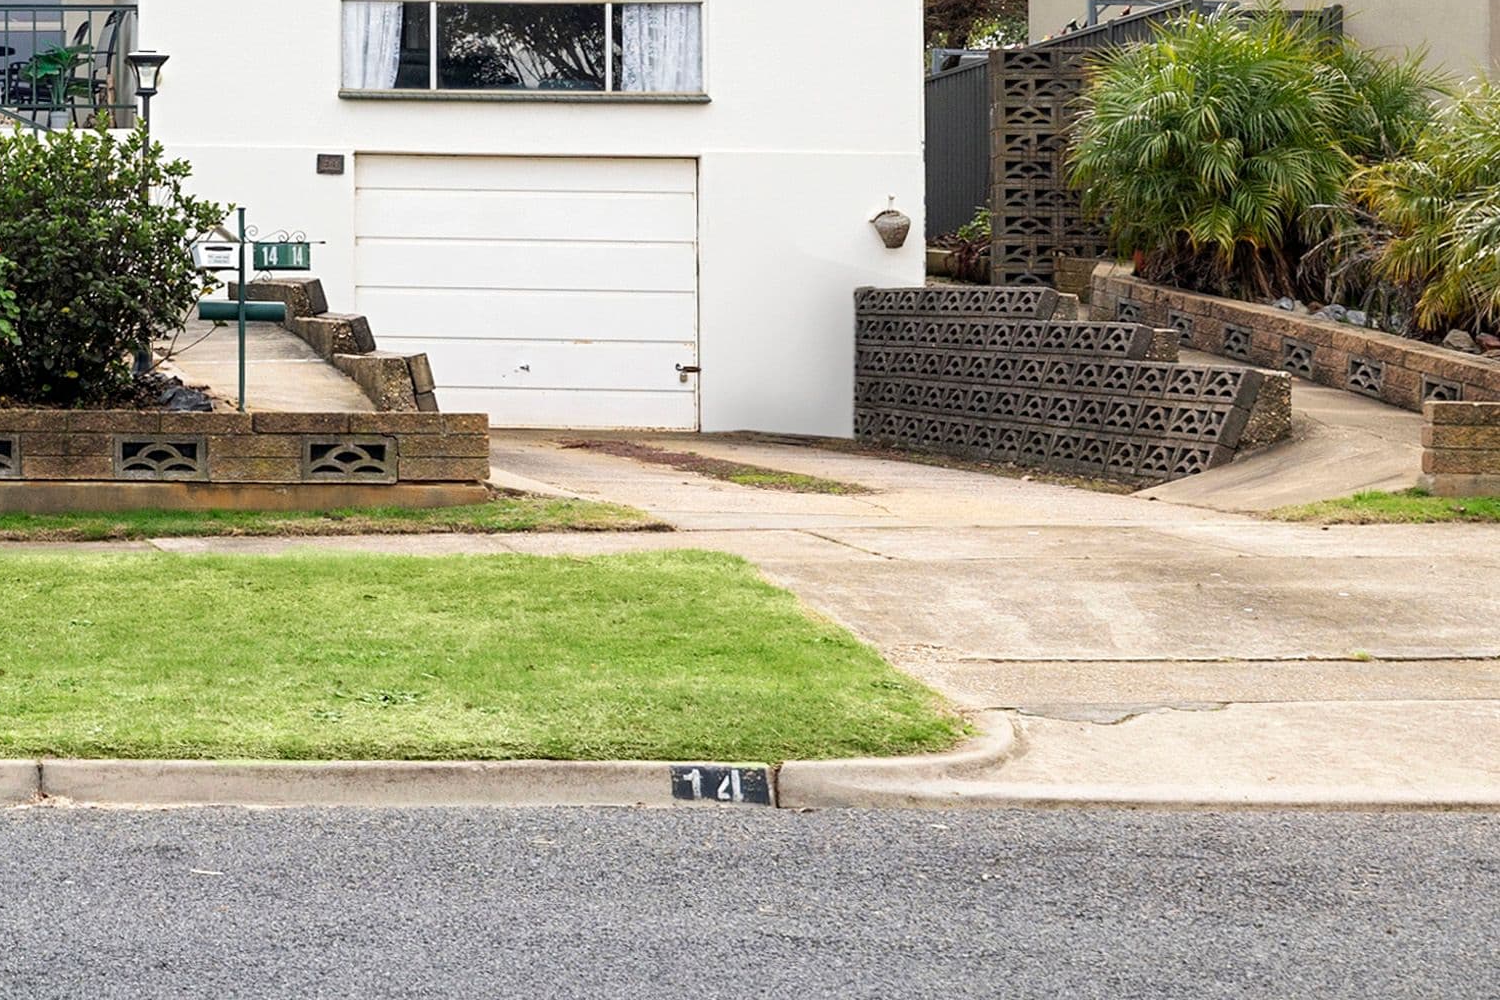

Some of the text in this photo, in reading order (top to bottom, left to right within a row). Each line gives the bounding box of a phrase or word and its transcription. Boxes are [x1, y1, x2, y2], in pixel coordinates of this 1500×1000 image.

[261, 246, 279, 267] 14
[292, 246, 303, 265] 14
[683, 768, 744, 801] 14
